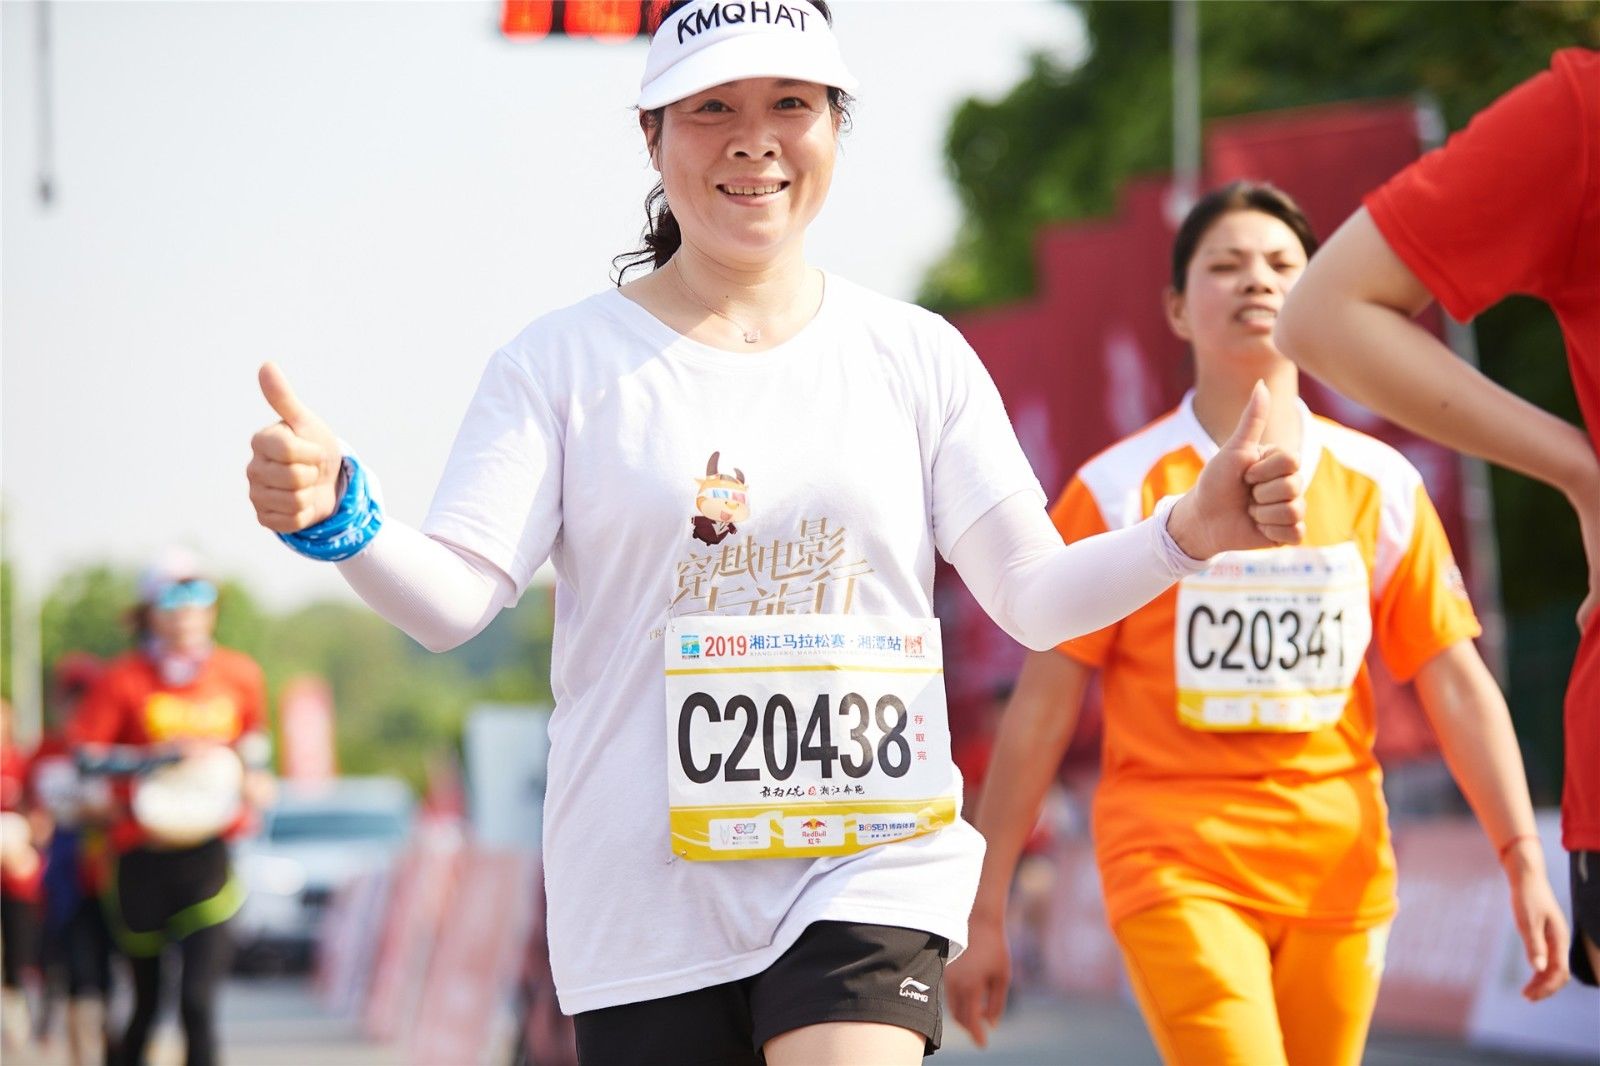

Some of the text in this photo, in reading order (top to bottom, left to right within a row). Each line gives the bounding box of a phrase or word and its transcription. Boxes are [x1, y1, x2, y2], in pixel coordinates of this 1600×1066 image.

[677, 1, 809, 44] KMQHAT
[705, 635, 747, 657] 2019
[1187, 604, 1344, 671] C20341
[677, 691, 911, 784] C20438
